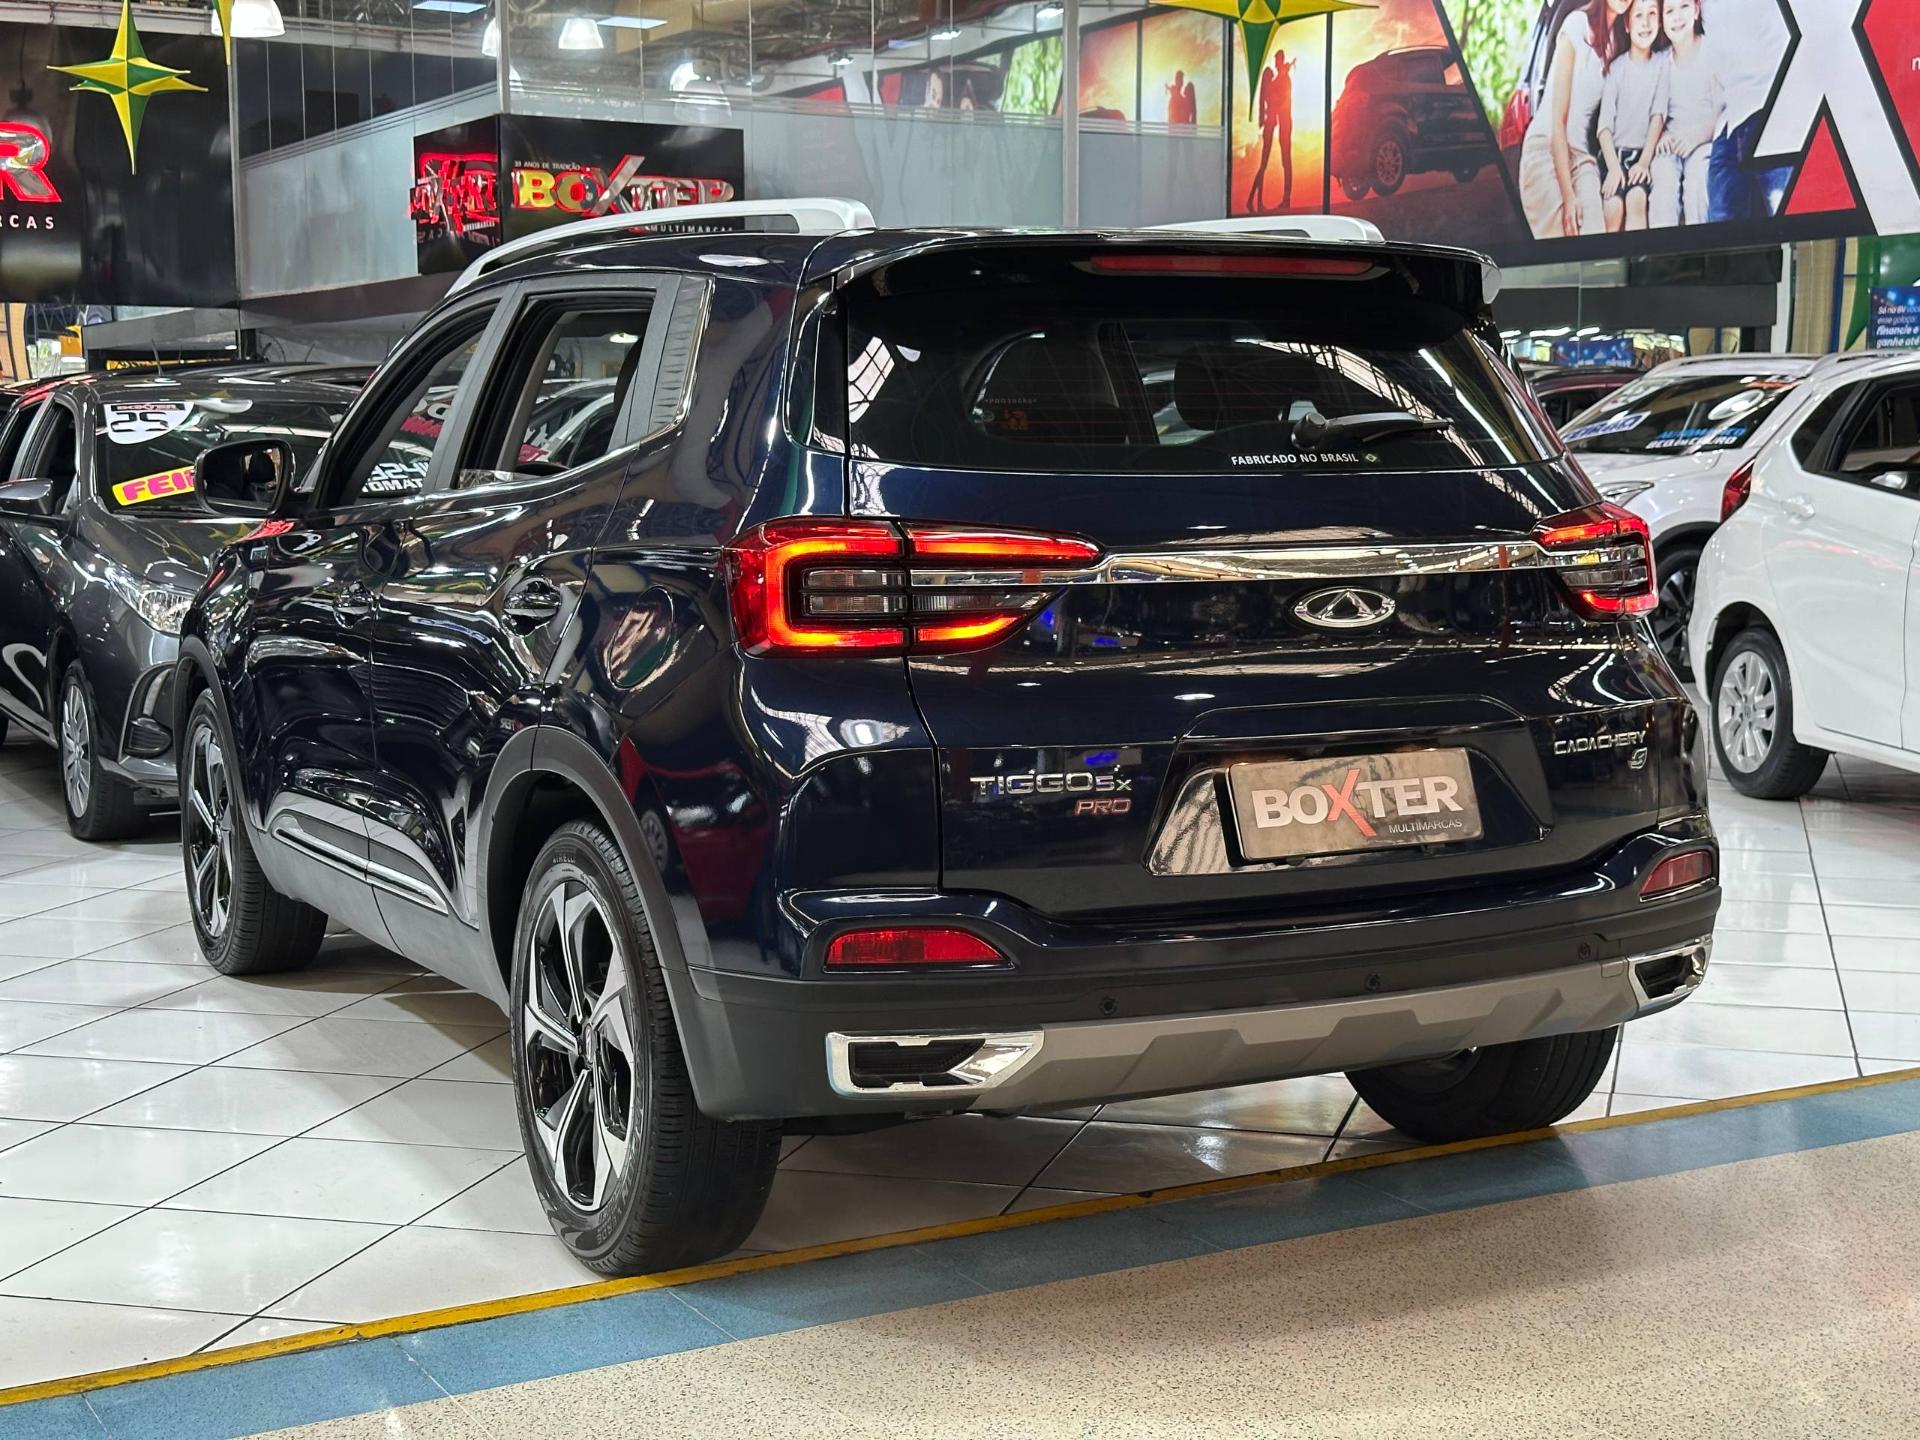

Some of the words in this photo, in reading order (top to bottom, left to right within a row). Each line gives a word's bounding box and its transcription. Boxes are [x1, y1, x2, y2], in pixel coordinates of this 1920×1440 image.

[511, 154, 735, 216] BOXTER
[1231, 454, 1297, 465] FABRICADO
[1300, 454, 1318, 463] NO
[1320, 453, 1359, 463] BRASIL
[1074, 797, 1132, 816] PRO
[1251, 768, 1465, 837] BOXTER
[1388, 818, 1463, 834] MULTIMARCAS
